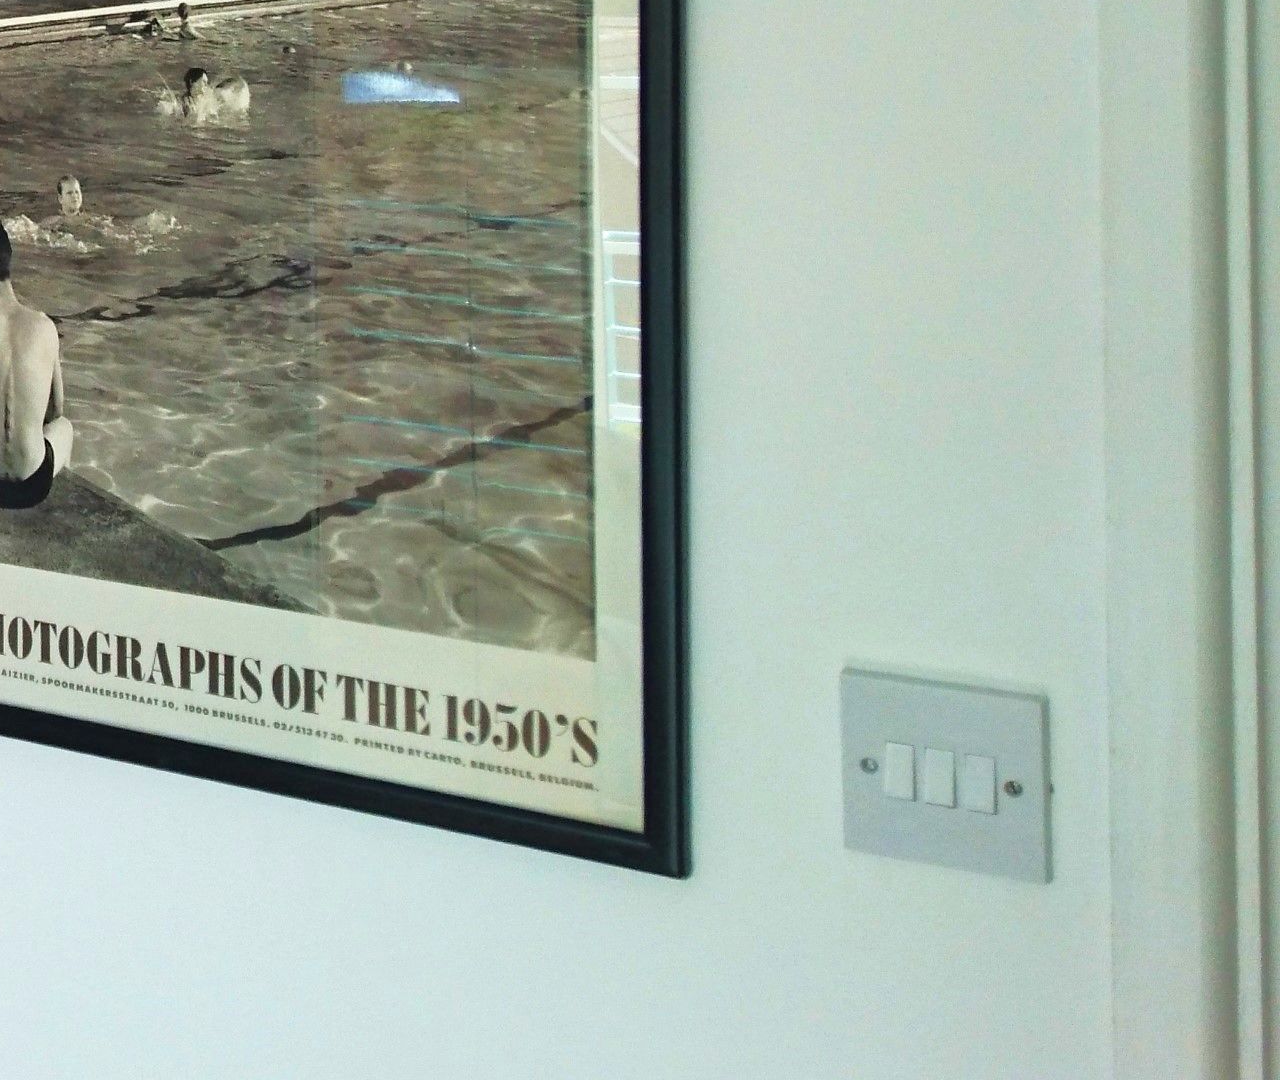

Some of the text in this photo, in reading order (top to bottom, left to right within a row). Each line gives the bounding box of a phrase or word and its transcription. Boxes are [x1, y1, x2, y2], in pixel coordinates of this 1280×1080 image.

[41, 676, 159, 706] SPOORMAKERSSTRAAT
[184, 704, 210, 716] 1000
[354, 737, 405, 754] PRINTED
[408, 747, 422, 757] BY
[271, 663, 328, 716] OF
[336, 673, 431, 737] THE
[441, 693, 599, 768] 1950'S
